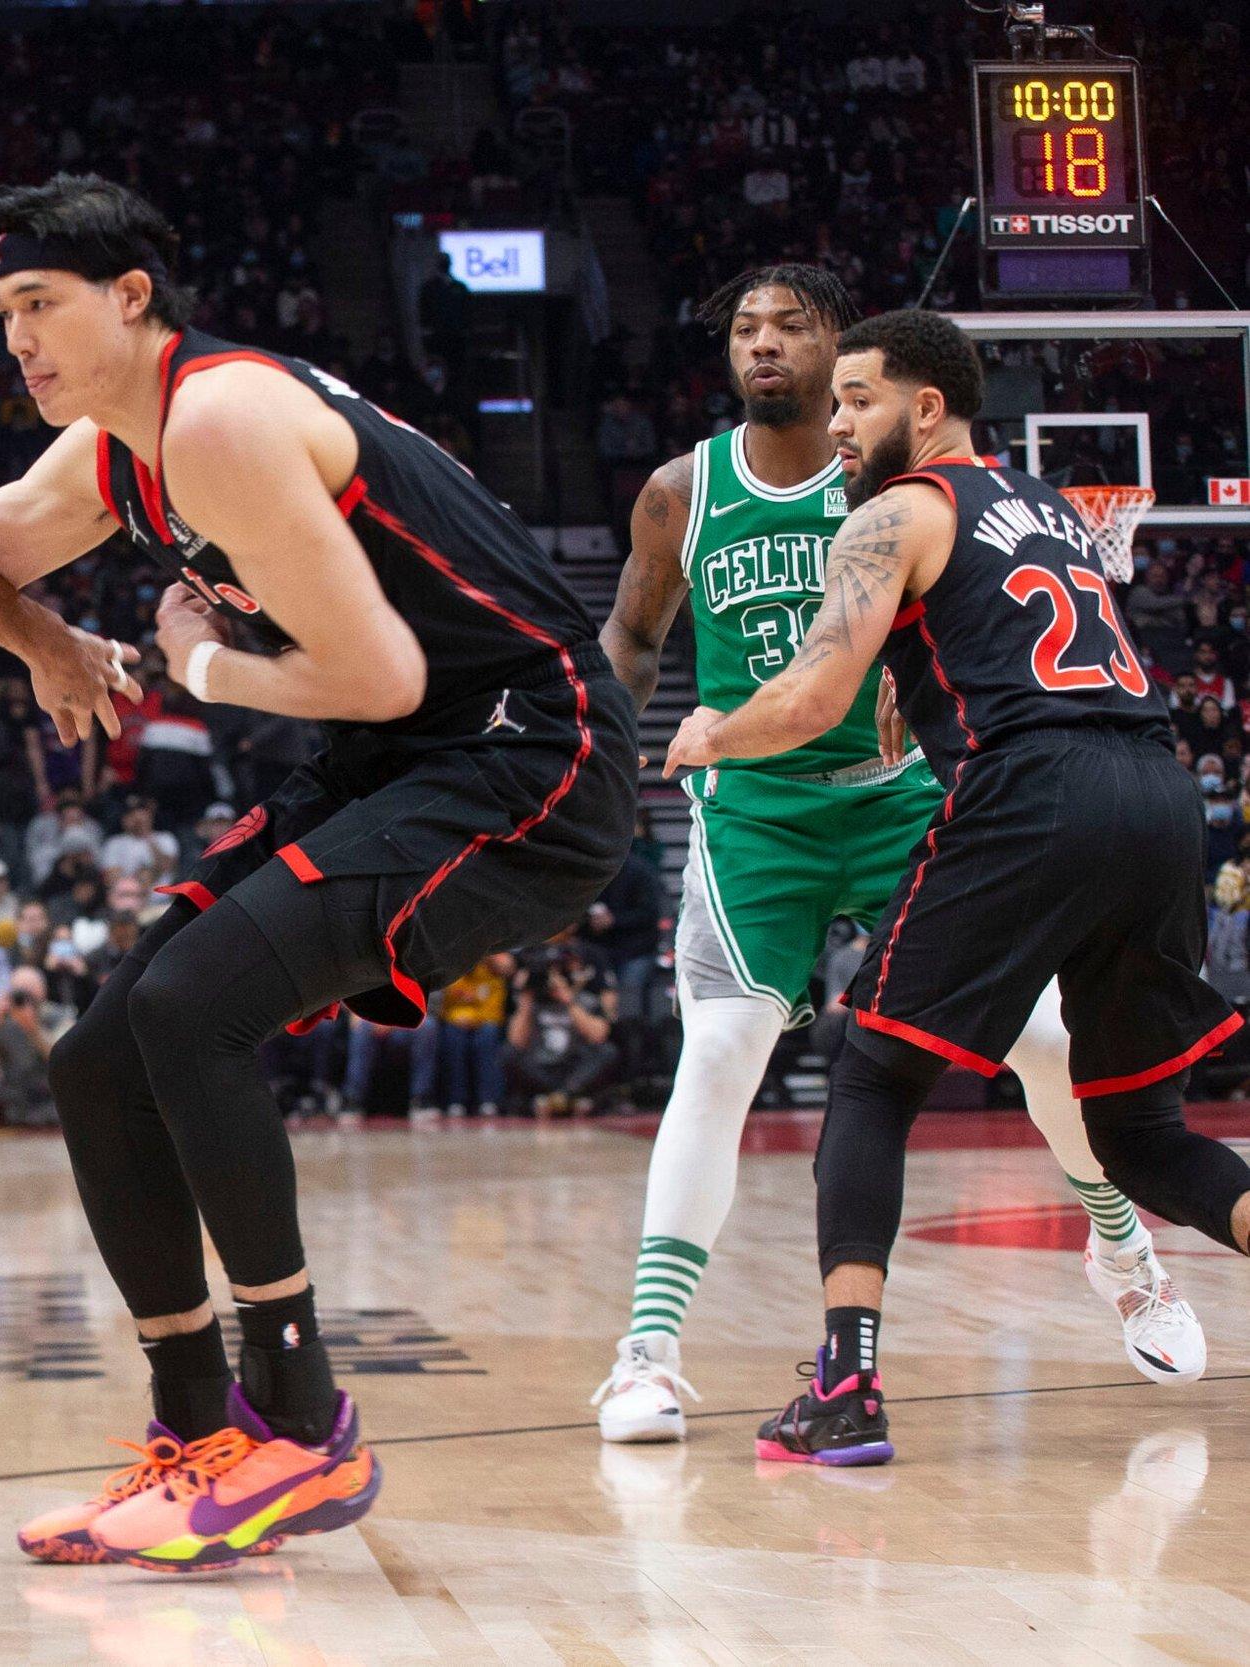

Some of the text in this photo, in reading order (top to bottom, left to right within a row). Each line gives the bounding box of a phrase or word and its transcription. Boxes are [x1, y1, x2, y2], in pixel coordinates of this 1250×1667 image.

[1014, 81, 1115, 122] 10:00
[1042, 127, 1107, 197] 18
[1031, 214, 1134, 234] TISSOT
[465, 246, 519, 277] Bell
[828, 491, 847, 503] VIS
[701, 533, 835, 615] CELTI
[1002, 564, 1149, 698] 23
